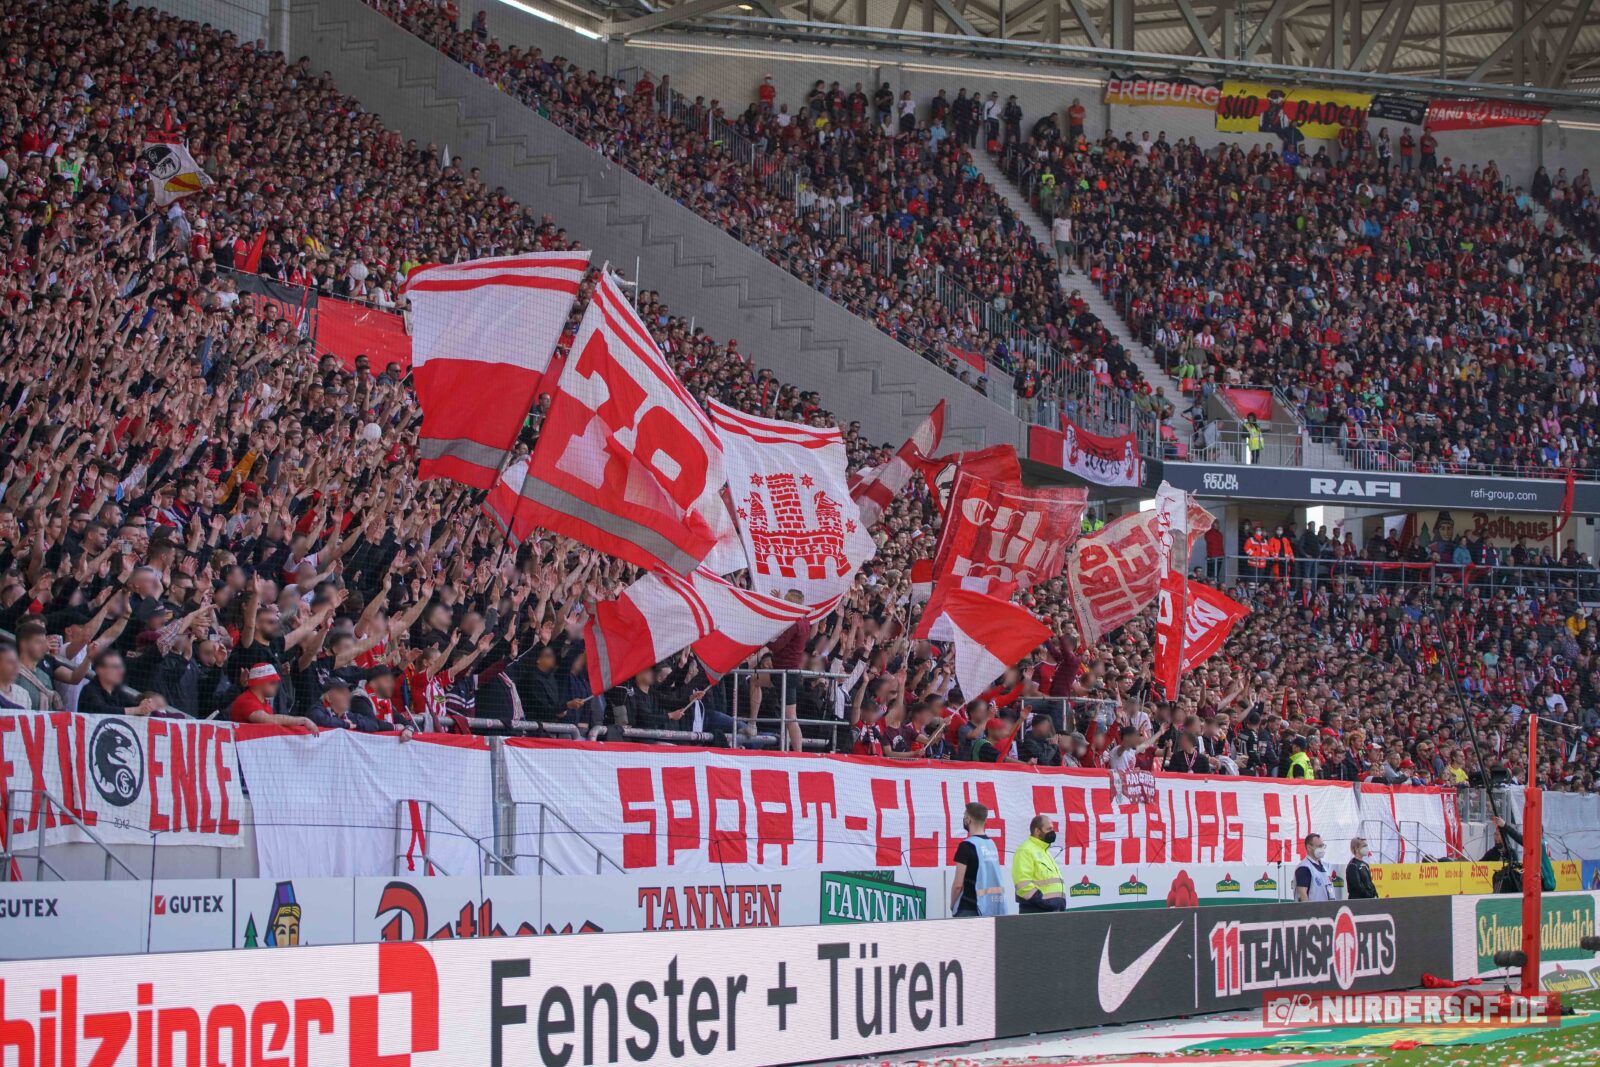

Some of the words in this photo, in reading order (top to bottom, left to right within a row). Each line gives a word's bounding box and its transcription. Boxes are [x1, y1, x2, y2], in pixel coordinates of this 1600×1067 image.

[1107, 79, 1221, 106] FREIBURG
[1224, 89, 1259, 119] SÜD
[1295, 100, 1369, 129] BADEN
[1203, 473, 1224, 483] GET
[1226, 474, 1237, 483] IN
[1204, 481, 1239, 490] TOUCH
[1310, 478, 1400, 498] RAFI
[1470, 488, 1537, 501] rafi-group.com
[755, 541, 847, 557] SYNTHESI
[617, 765, 1005, 868] SPORT-CLUB
[1032, 785, 1243, 867] FREIBURG
[1370, 867, 1383, 880] OTTO
[1425, 865, 1439, 879] LOTTO
[0, 898, 58, 918] GUTEX
[169, 896, 223, 913] GUTEX
[638, 884, 781, 931] TANNEN
[825, 880, 921, 922] TANNEN
[1478, 908, 1594, 957] Schwaraldmilch
[490, 954, 748, 1067] Fenster
[767, 962, 798, 1031] +
[818, 942, 964, 1040] Türen
